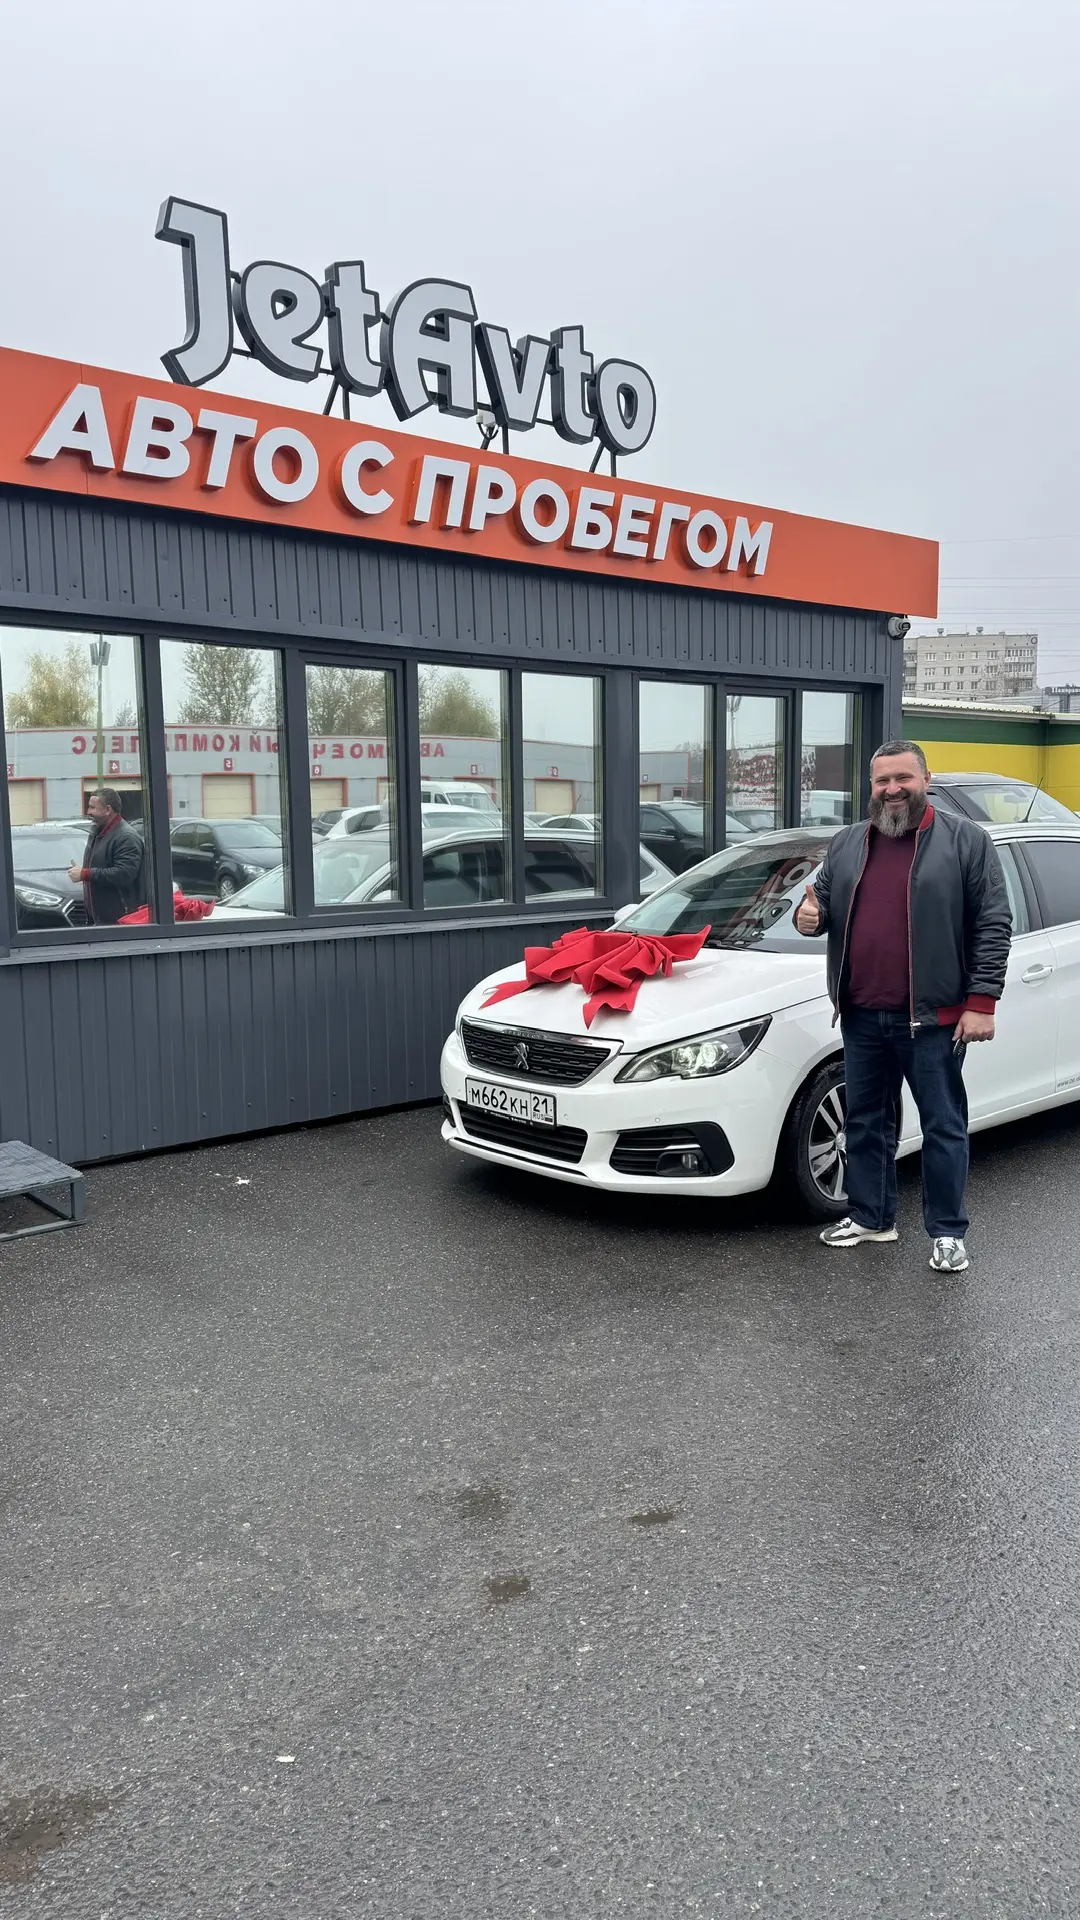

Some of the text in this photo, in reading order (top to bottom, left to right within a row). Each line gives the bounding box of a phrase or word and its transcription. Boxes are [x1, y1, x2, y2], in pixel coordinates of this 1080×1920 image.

[155, 196, 656, 456] JetAvto
[25, 383, 773, 577] АВТО С ПРОБЕГОМ
[471, 1086, 548, 1117] М662КН 21
[533, 1112, 545, 1121] RUS
